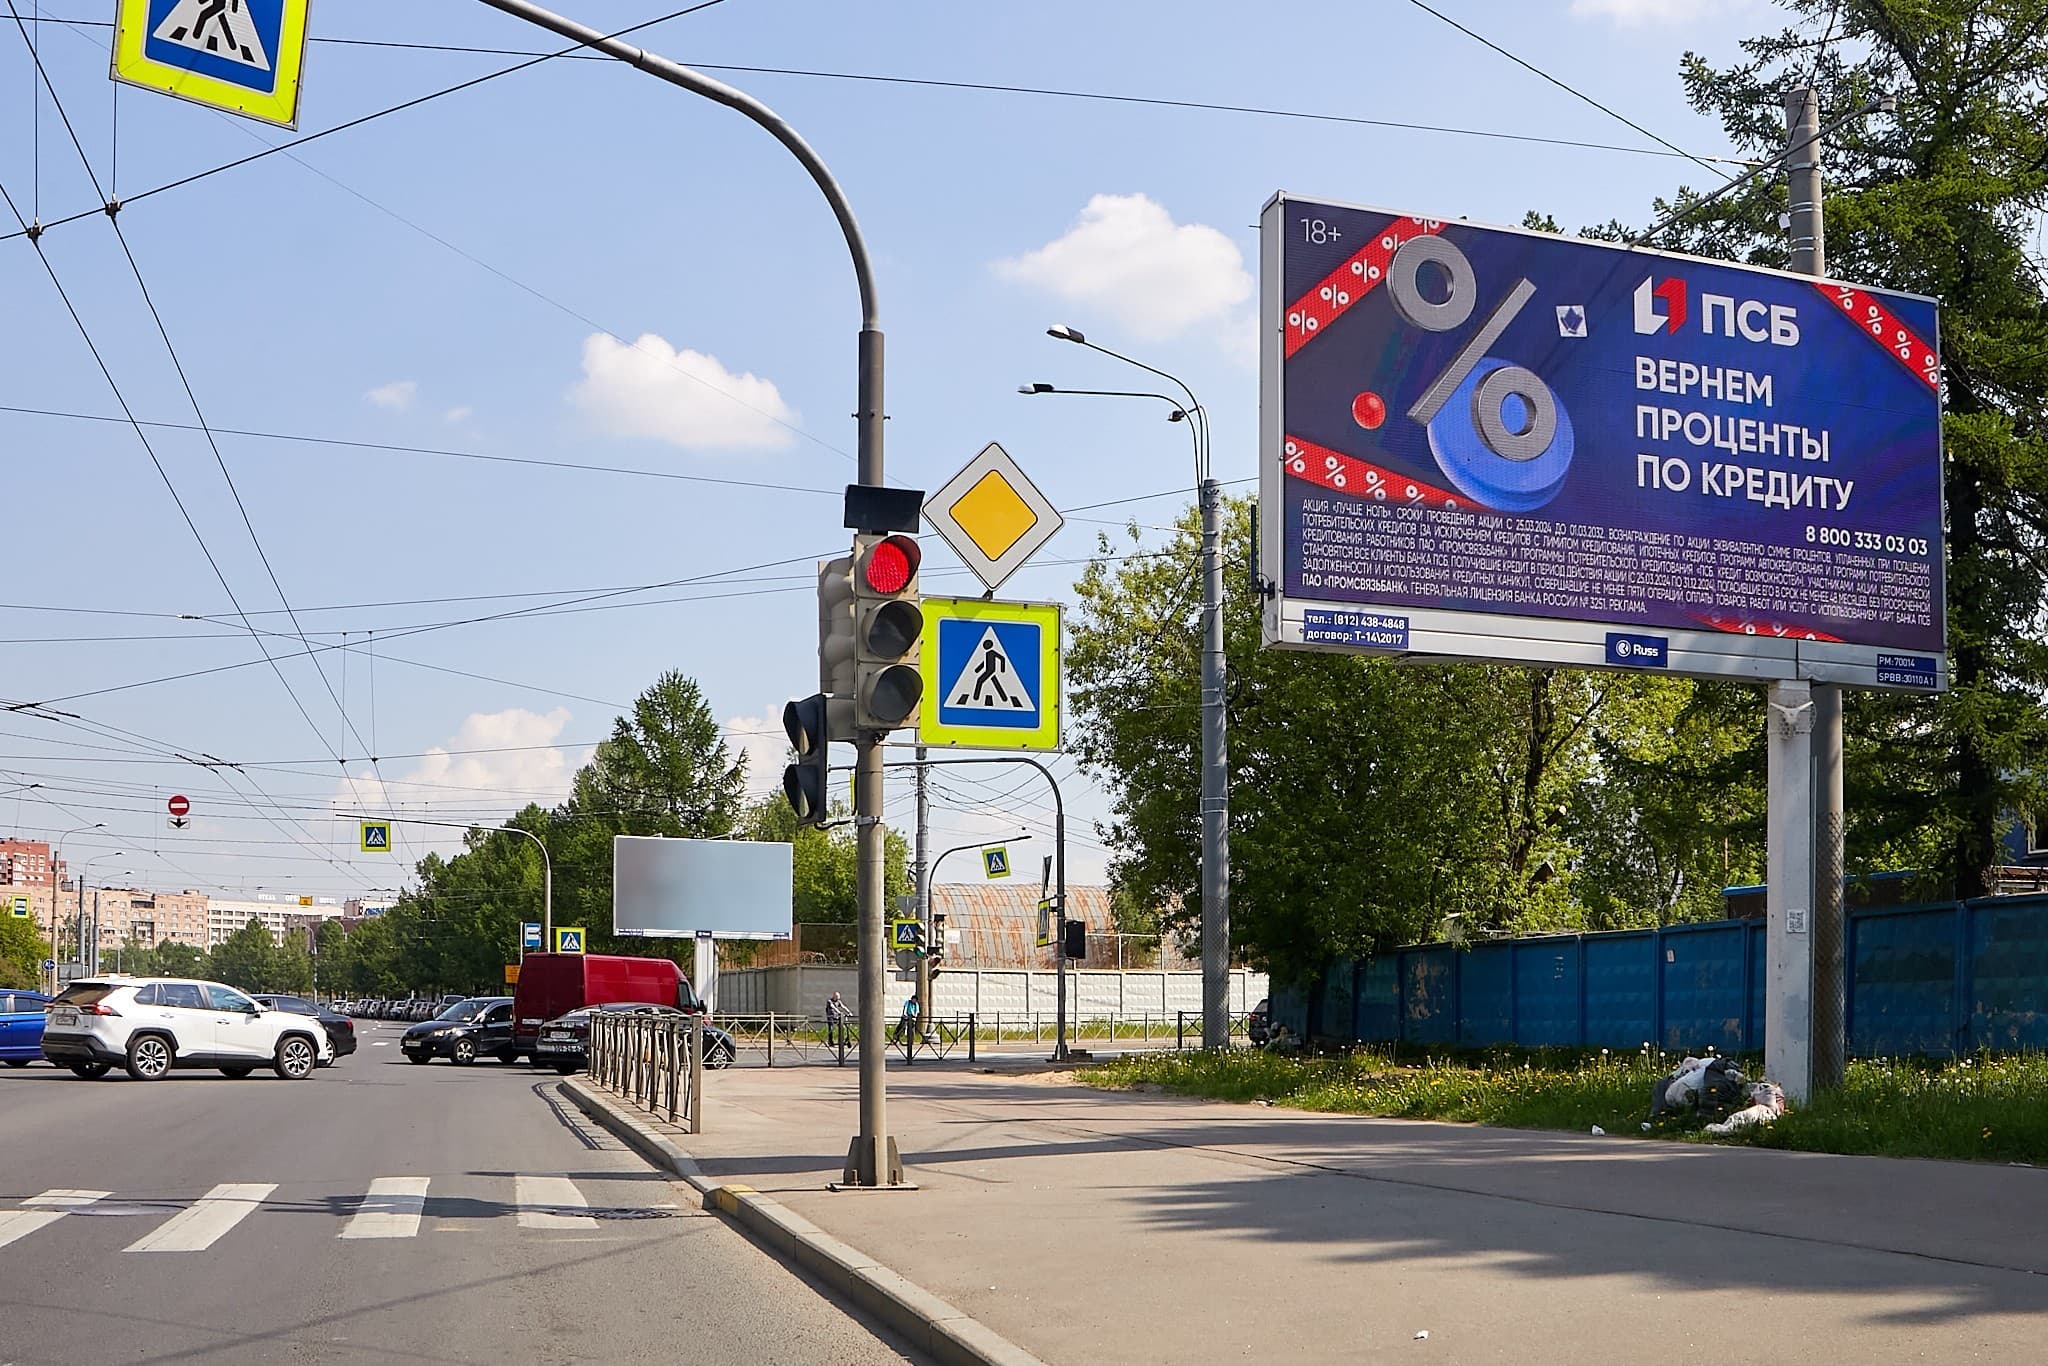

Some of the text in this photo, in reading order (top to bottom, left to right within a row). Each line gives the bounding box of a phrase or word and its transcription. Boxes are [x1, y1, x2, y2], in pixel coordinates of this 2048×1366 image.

[1300, 218, 1342, 244] 18+
[1701, 293, 1800, 347] ПСБ
[1635, 355, 1773, 407] ВЕРНЕМ
[1636, 404, 1829, 462] ПРОЦЕНТЫ
[1637, 453, 1854, 510] ПО КРЕДИТУ
[1302, 497, 1328, 513] АКЦИЯ
[1332, 500, 1363, 515] «ЛУЧШЕ
[1396, 507, 1422, 521] СРОКИ
[1426, 509, 1474, 526] ПРОВЕДЕНИЯ
[1478, 514, 1503, 529] АКЦИИ
[1506, 517, 1512, 529] С
[1554, 522, 1566, 535] ДО
[1608, 527, 1670, 546] ВОЗНАГРАЖДЕНИЕ
[1673, 534, 1684, 547] ПО
[1687, 536, 1709, 550] АКЦИИ
[1302, 512, 1375, 531] ПОТРЕБИТЕЛЬСКИХ
[1378, 519, 1416, 536] КРЕДИТОВ
[1434, 524, 1491, 542] ИСКЛЮЧЕНИЕМ
[1493, 530, 1530, 546] КРЕДИТОВ
[1533, 534, 1540, 546] С
[1542, 534, 1578, 550] ЛИМИТОМ
[1639, 544, 1679, 560] ИПОТЕЧНЫХ
[1719, 553, 1755, 568] ПРОГРАММ
[1806, 525, 1928, 555] 8 800 333 03 03
[1302, 527, 1362, 546] КРЕДИТОВАНИЯ
[1366, 532, 1415, 549] РАБОТНИКОВ
[1418, 537, 1435, 551] ПАО
[1511, 546, 1517, 558] И
[1520, 546, 1564, 563] ПРОГРАММЫ
[1568, 551, 1638, 570] ПОТРЕБИТЕЛЬСКОГО
[1641, 558, 1693, 576] КРЕДИТОВАНИЯ
[1718, 566, 1742, 581] КРЕДИТ
[1302, 542, 1353, 559] СТАНОВЯТСЯ
[1354, 546, 1369, 560] ВСЕ
[1370, 548, 1404, 563] КЛИЕНТЫ
[1406, 551, 1431, 565] БАНКА
[1450, 554, 1501, 571] ПОЛУЧИВШИЕ
[1503, 559, 1529, 574] КРЕДИТ
[1530, 561, 1536, 574] В
[1536, 562, 1564, 577] ПЕРИОД
[1565, 565, 1603, 581] ДЕЙСТВИЯ
[1603, 568, 1627, 583] АКЦИИ
[1302, 556, 1372, 575] ЗАДОЛЖЕННОСТИ
[1374, 562, 1381, 575] И
[1383, 563, 1449, 581] ИСПОЛЬЗОВАНИЯ
[1453, 569, 1495, 585] КРЕДИТНЫХ
[1534, 576, 1589, 593] СОВЕРШАВШИЕ
[1591, 581, 1600, 594] НЕ
[1602, 582, 1625, 596] МЕНЕЕ
[1627, 584, 1645, 598] ПЯТИ
[1302, 573, 1321, 588] ПАО
[1410, 581, 1468, 598] ГЕНЕРАЛЬНАЯ
[1469, 586, 1513, 603] ЛИЦЕНЗИЯ
[1514, 590, 1541, 604] БАНКА
[1542, 592, 1578, 607] РОССИИ
[1306, 613, 1405, 630] тел.: (812) 438-4848
[1306, 630, 1353, 643] договор:
[1633, 643, 1659, 657] Russ
